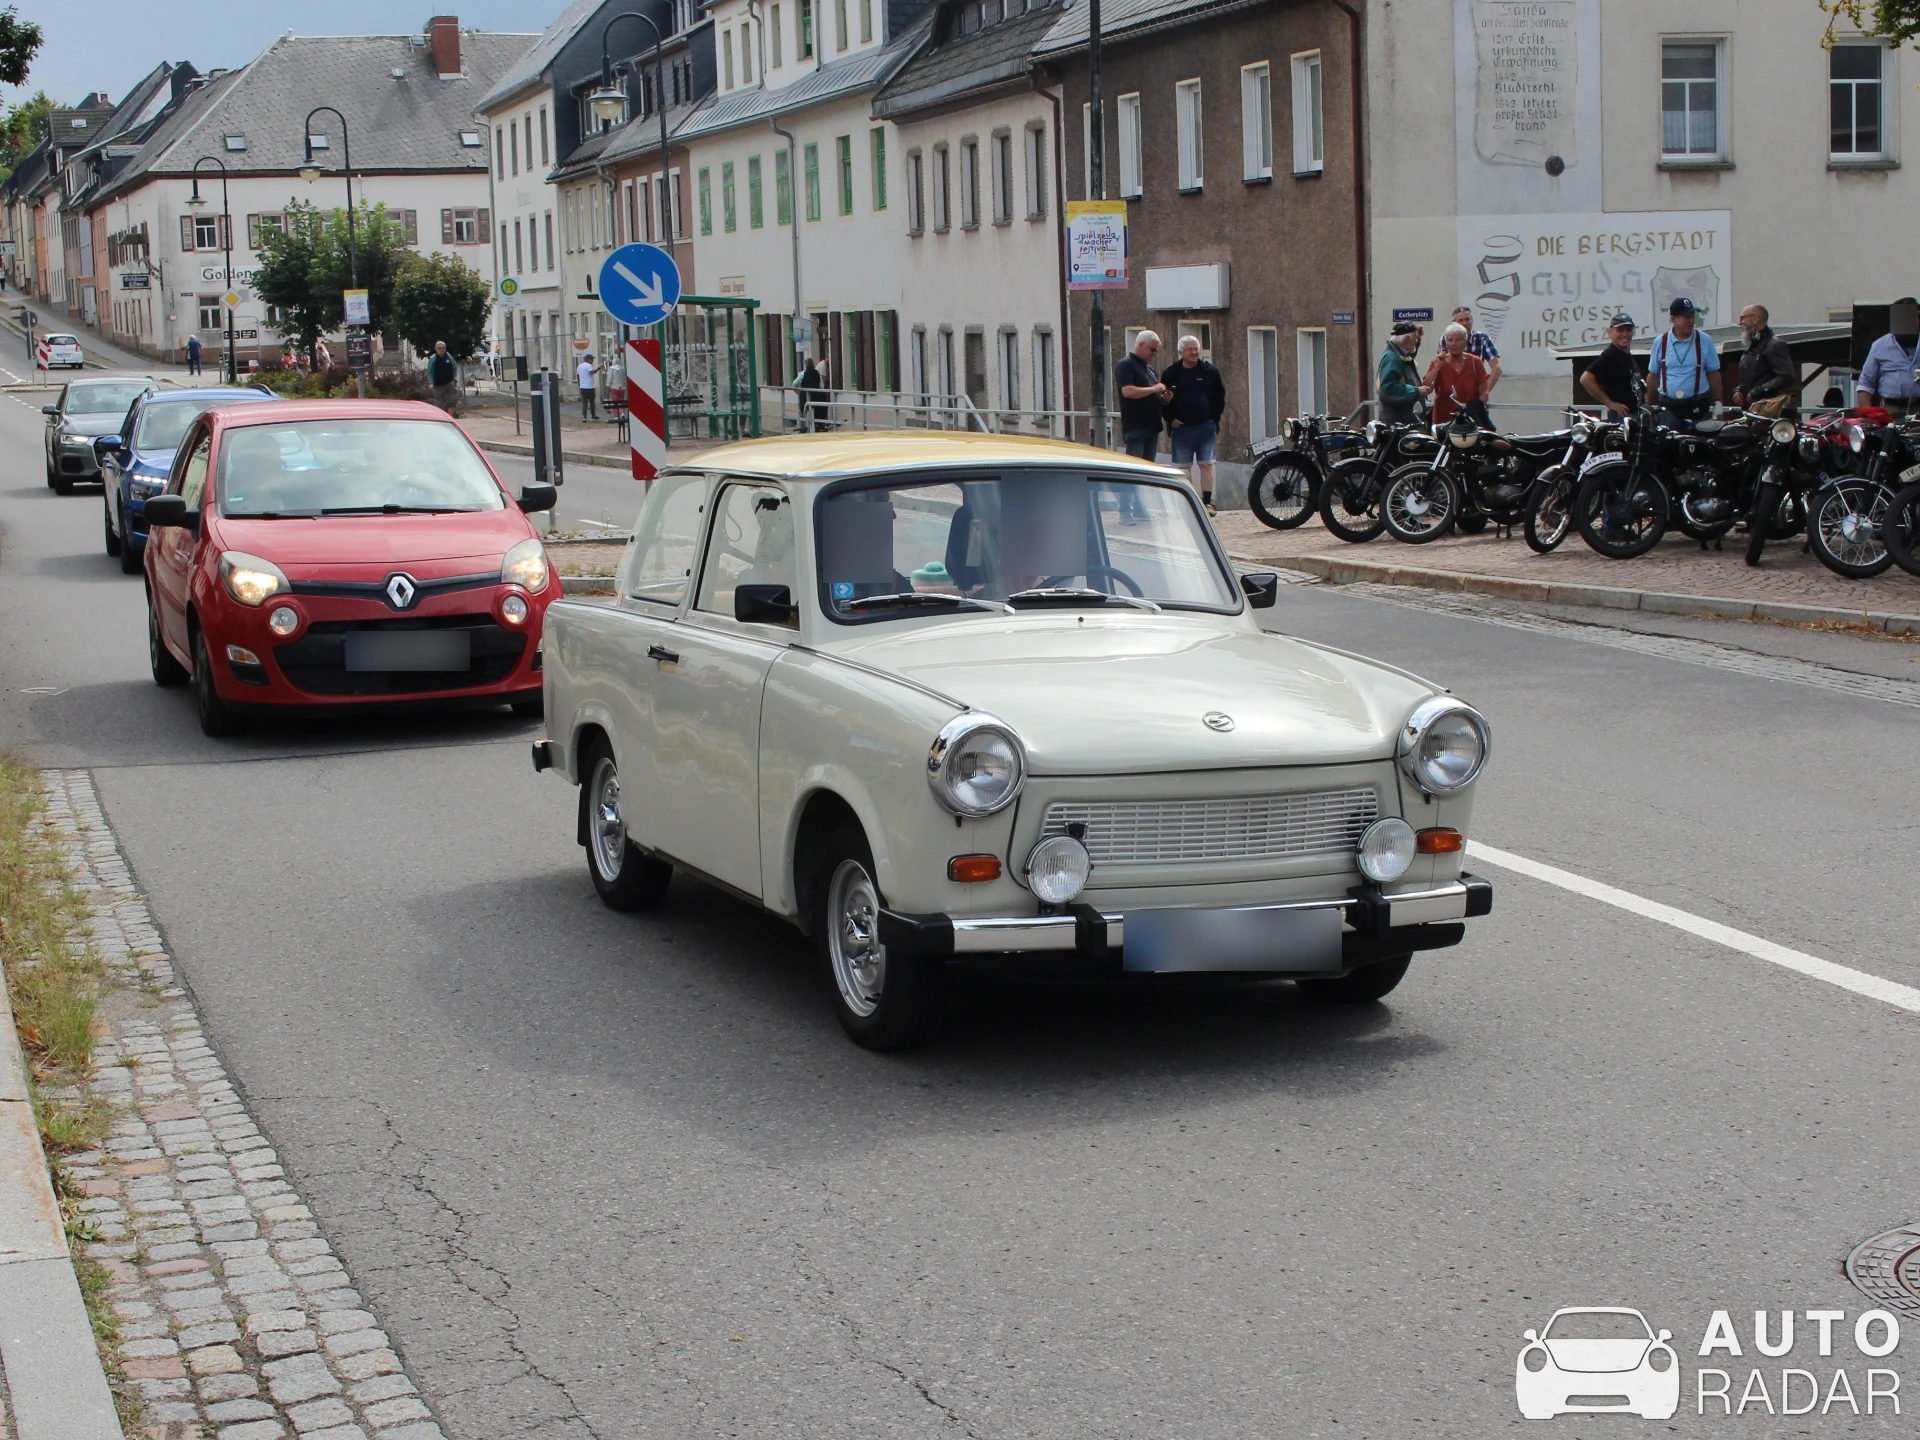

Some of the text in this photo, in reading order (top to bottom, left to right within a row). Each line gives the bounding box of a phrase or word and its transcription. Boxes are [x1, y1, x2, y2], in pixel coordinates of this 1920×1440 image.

[1501, 4, 1546, 17] Sayda
[1492, 46, 1557, 56] urkundliche
[1494, 82, 1556, 94] Stadtrecht
[1515, 120, 1546, 131] brand
[1537, 230, 1716, 257] DIE BERGSTADT
[1475, 235, 1645, 315] Sayda
[1521, 328, 1571, 349] IHRE
